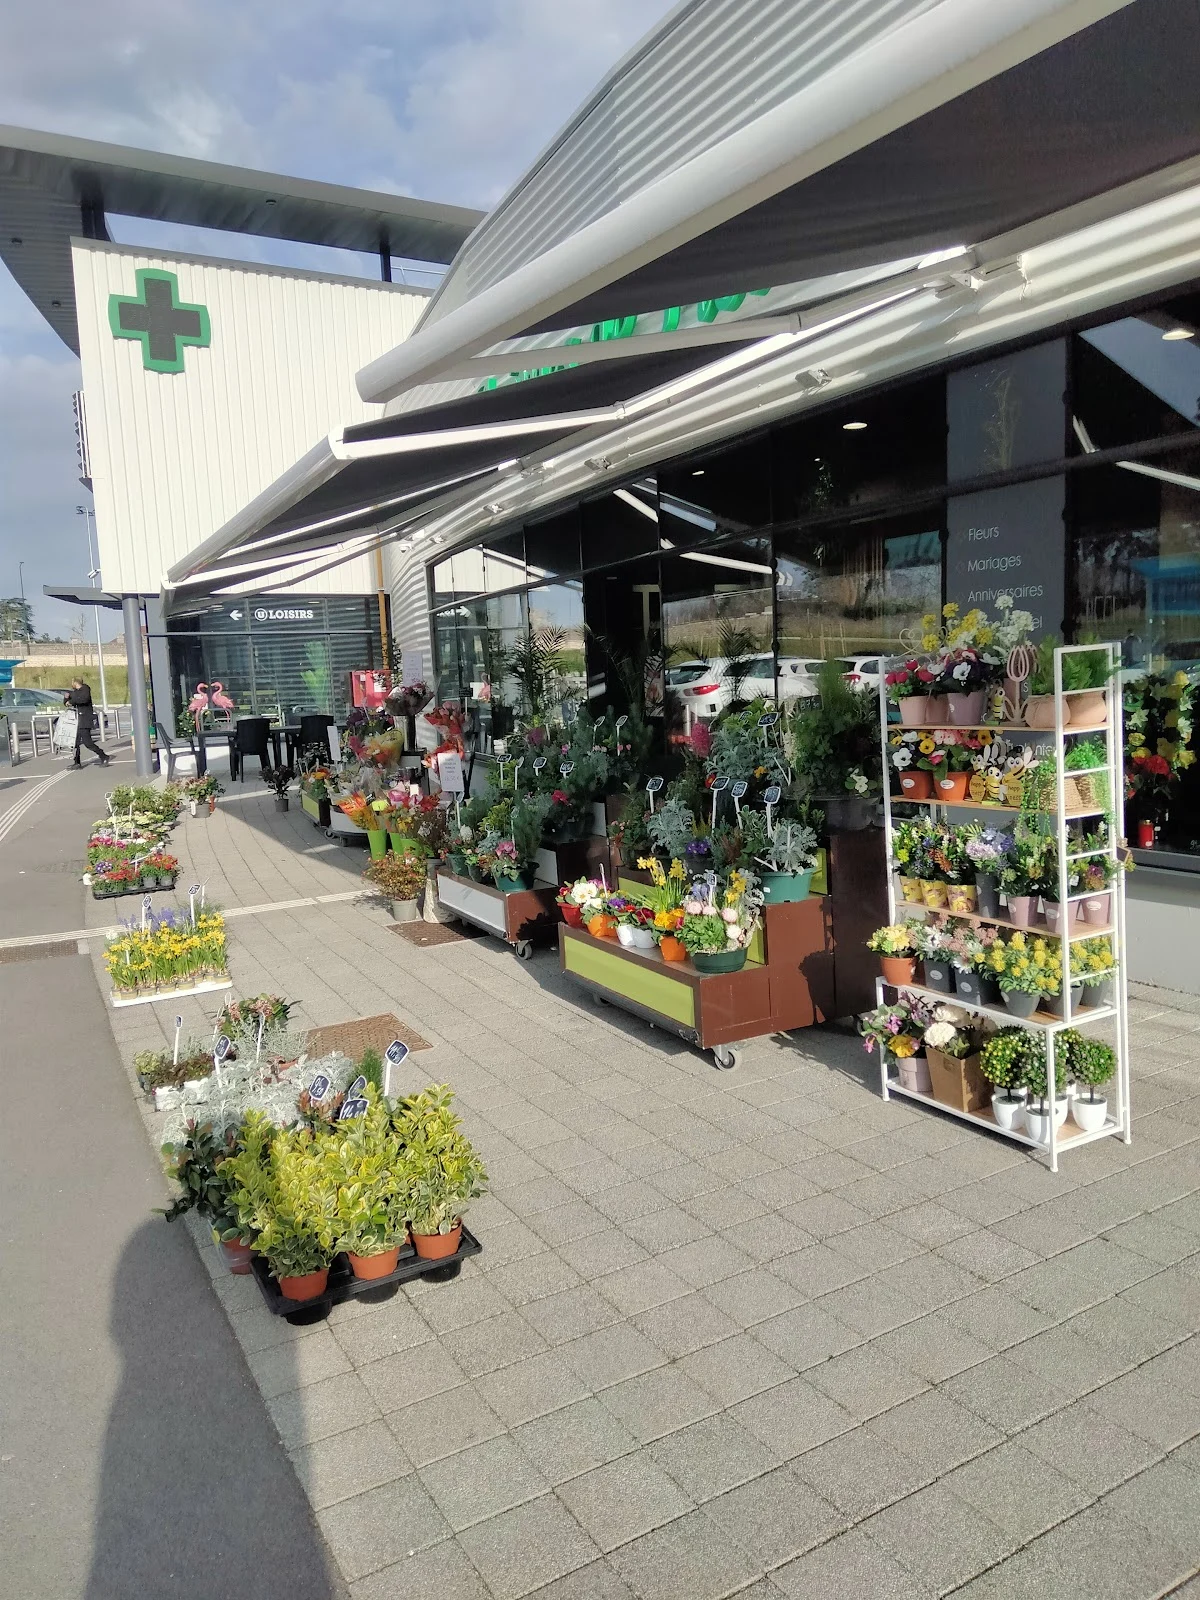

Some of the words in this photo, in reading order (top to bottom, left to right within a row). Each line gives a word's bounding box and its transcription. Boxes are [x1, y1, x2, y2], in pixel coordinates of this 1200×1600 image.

[968, 526, 1000, 541] Fleurs
[967, 555, 1022, 572] Mariages
[967, 584, 1044, 603] Anniversaires
[268, 609, 314, 619] LOISIRS
